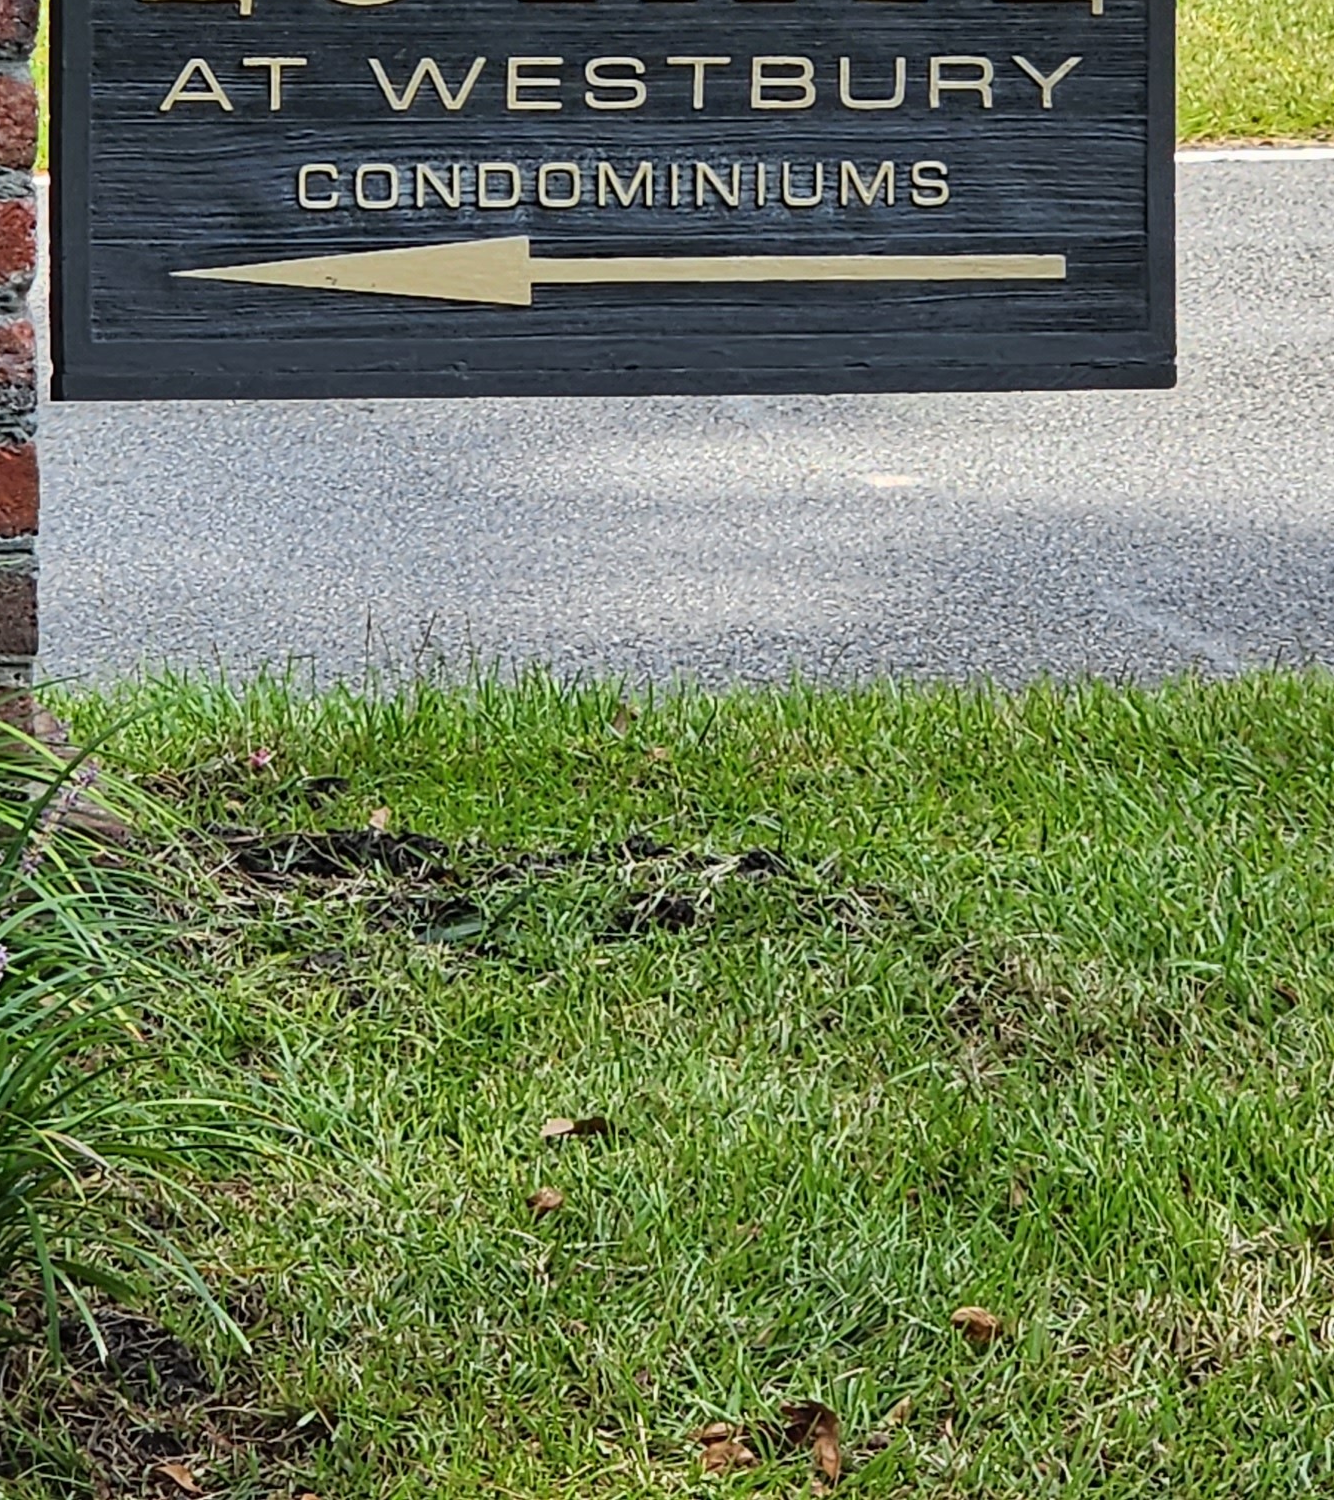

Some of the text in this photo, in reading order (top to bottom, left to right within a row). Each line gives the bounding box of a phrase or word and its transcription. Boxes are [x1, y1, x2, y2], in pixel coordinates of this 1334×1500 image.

[160, 55, 1084, 112] AT WESTBURY
[297, 161, 952, 209] CONDOMINIUMS
